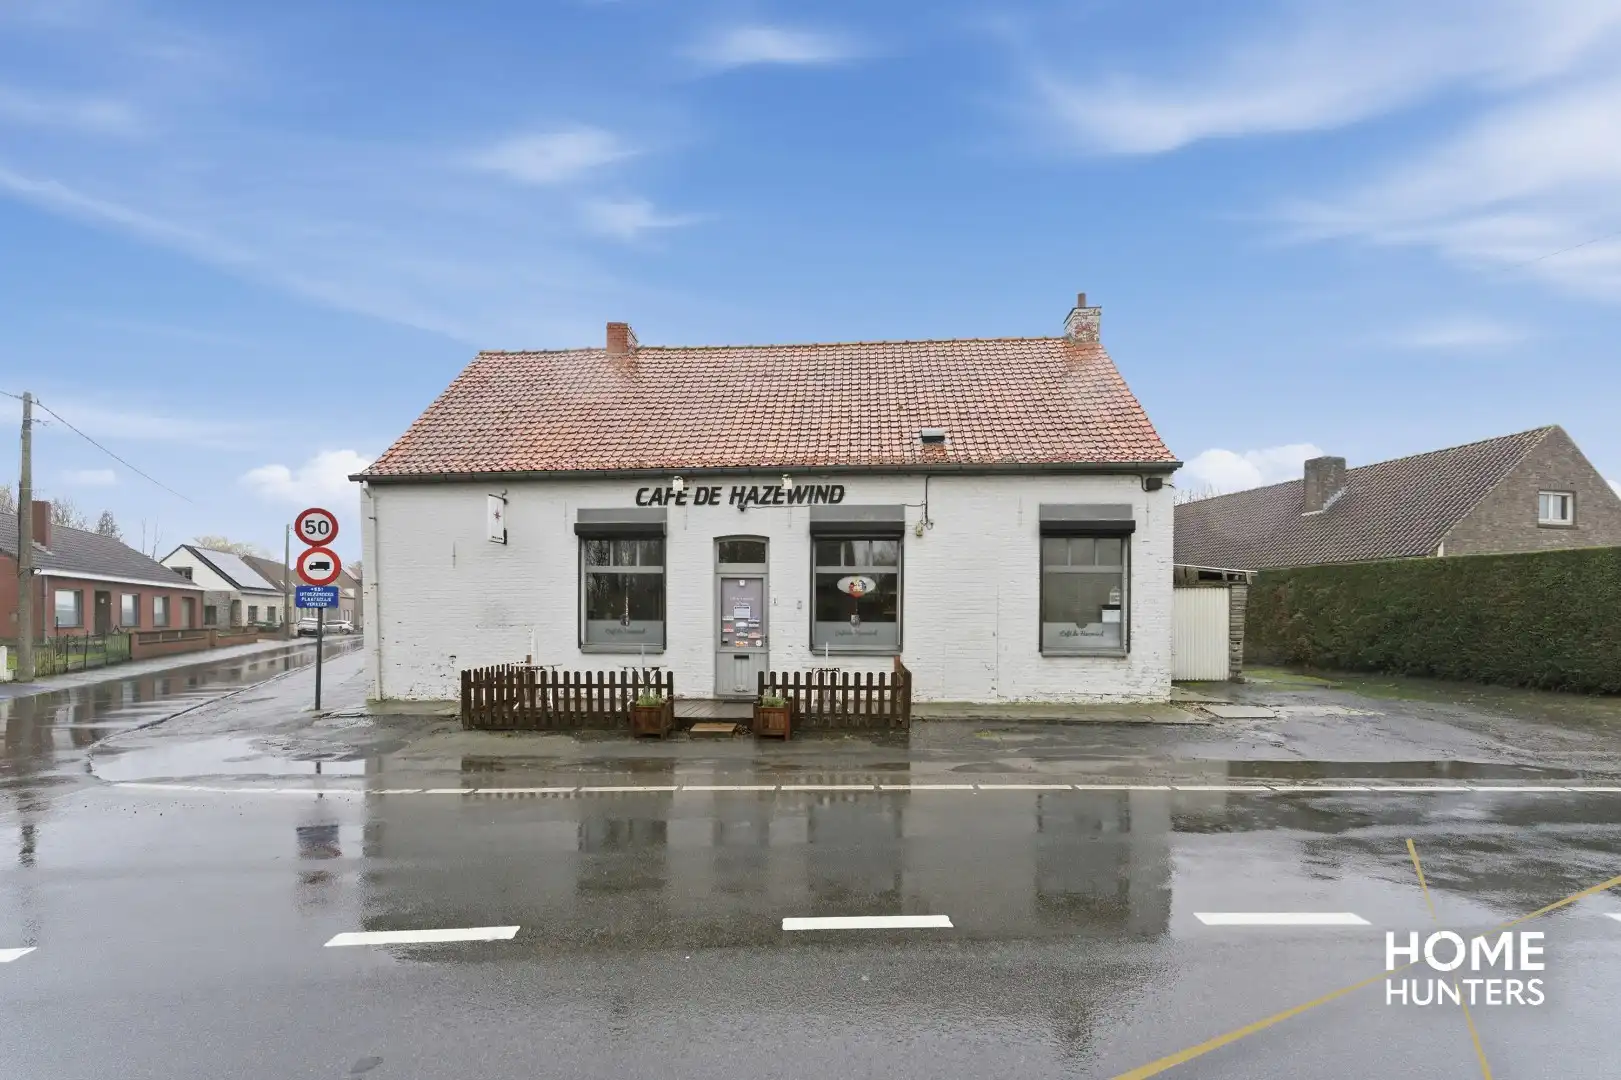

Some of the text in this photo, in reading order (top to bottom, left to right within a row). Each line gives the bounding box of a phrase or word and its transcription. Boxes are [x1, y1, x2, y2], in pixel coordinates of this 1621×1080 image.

[693, 486, 722, 506] DE
[729, 485, 845, 505] HAZEWIND
[304, 519, 329, 535] 50
